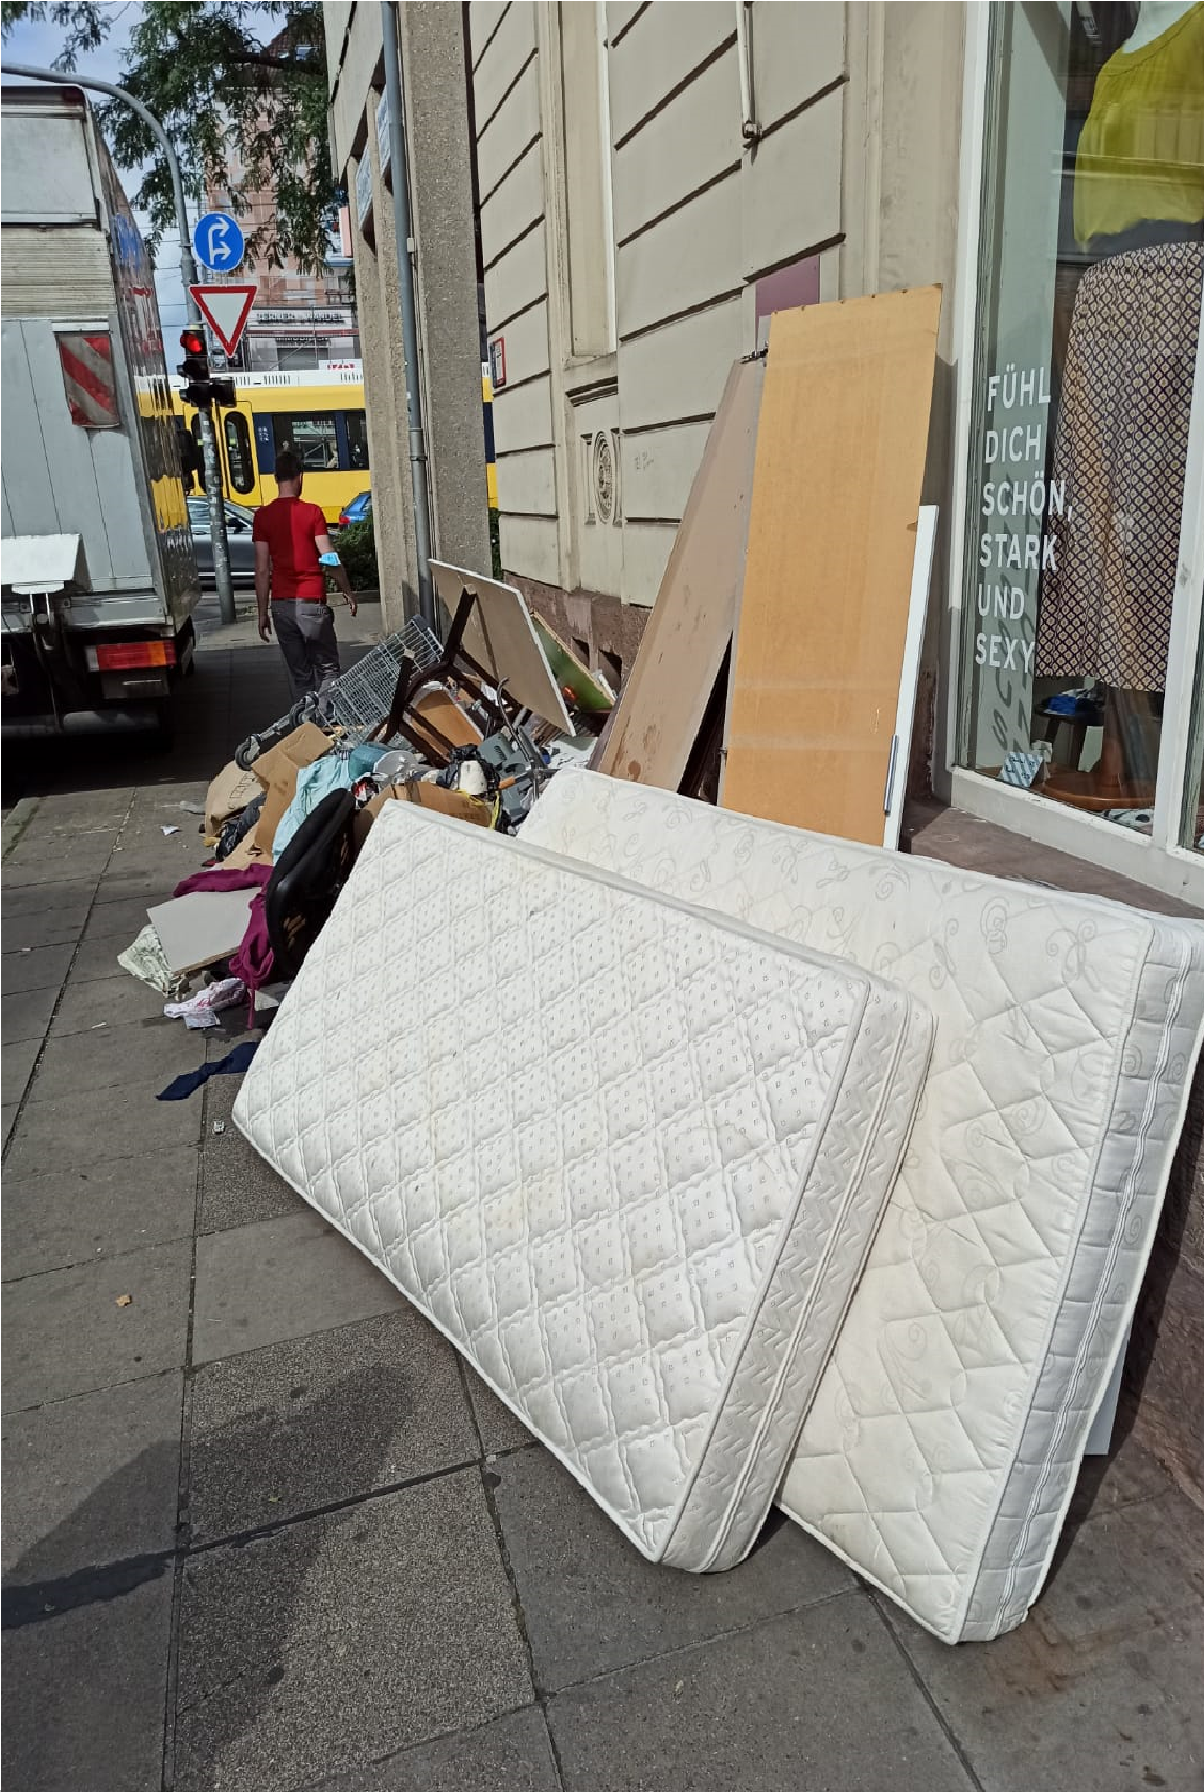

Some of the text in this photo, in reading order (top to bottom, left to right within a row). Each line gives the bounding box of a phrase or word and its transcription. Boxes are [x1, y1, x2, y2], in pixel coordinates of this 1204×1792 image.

[987, 363, 1051, 412] FÜHL
[985, 424, 1042, 464] DICH
[981, 470, 1073, 522] SCHÖN,
[979, 532, 1058, 572] STARK
[977, 583, 1025, 620] UND
[975, 631, 1036, 674] SEXY
